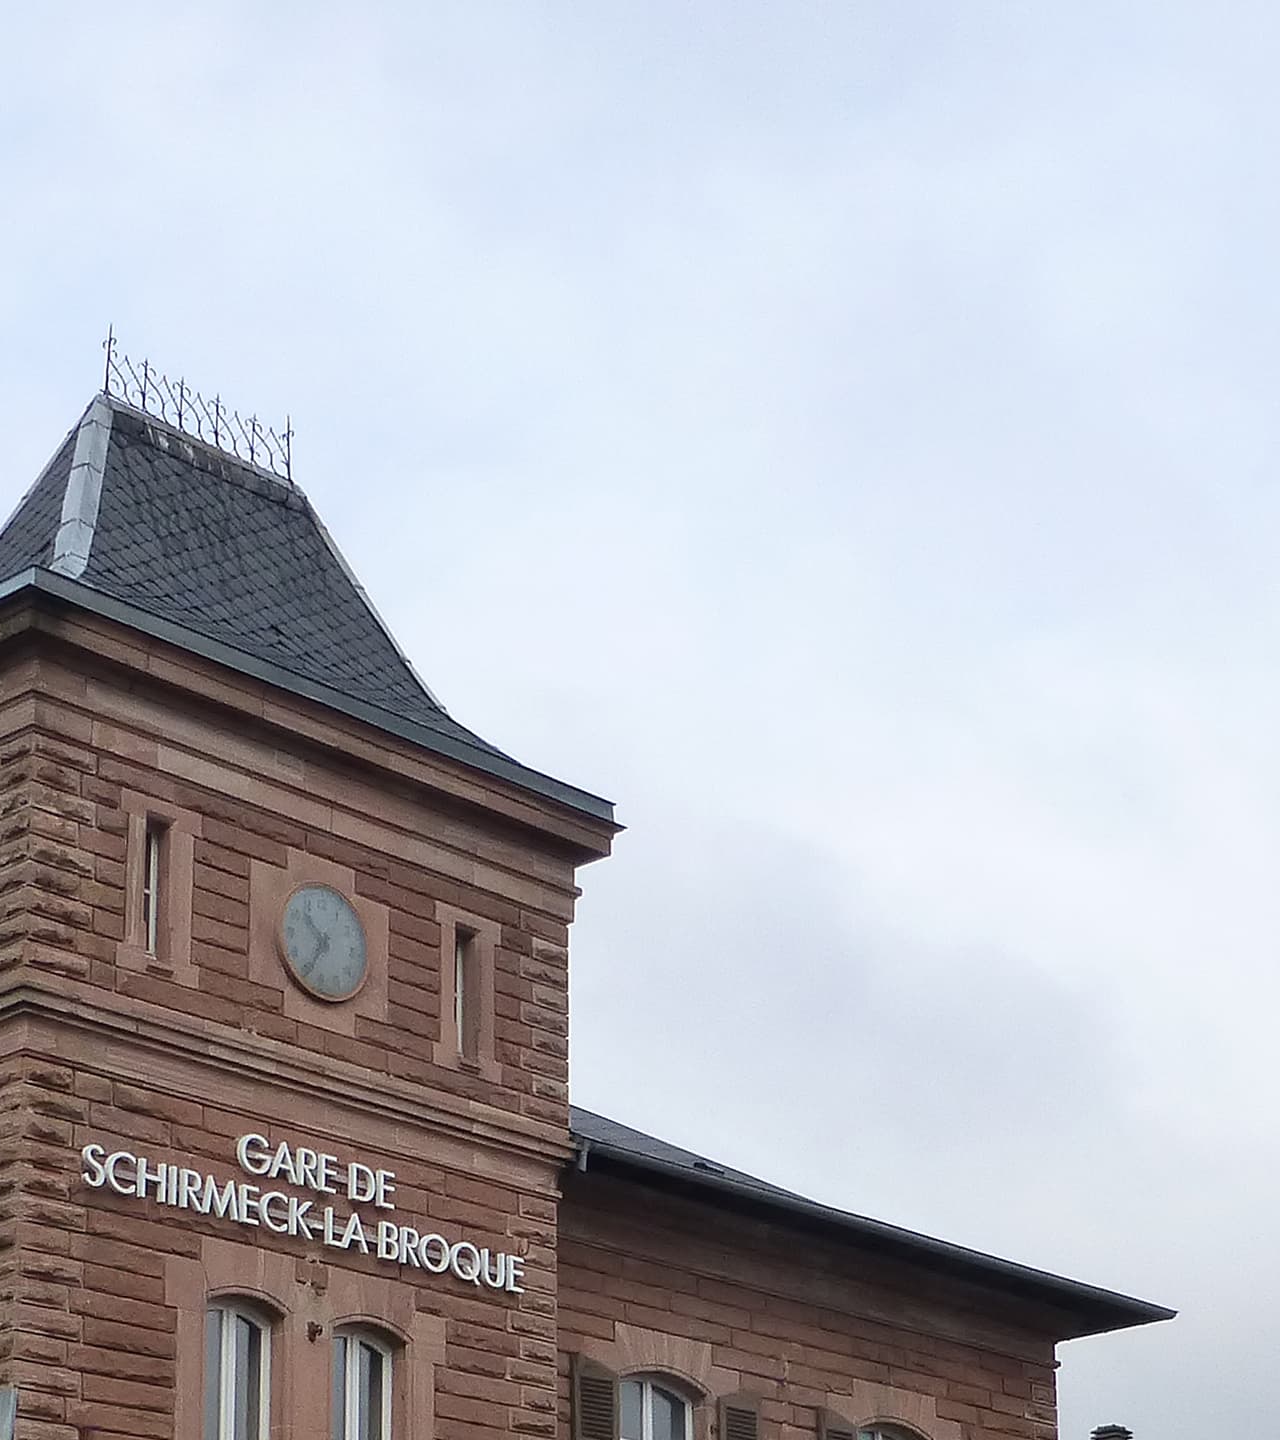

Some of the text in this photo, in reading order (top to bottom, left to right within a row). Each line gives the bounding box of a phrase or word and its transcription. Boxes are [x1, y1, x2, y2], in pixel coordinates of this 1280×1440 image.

[237, 1133, 396, 1210] GARE DE
[377, 1220, 525, 1293] BROQUE
